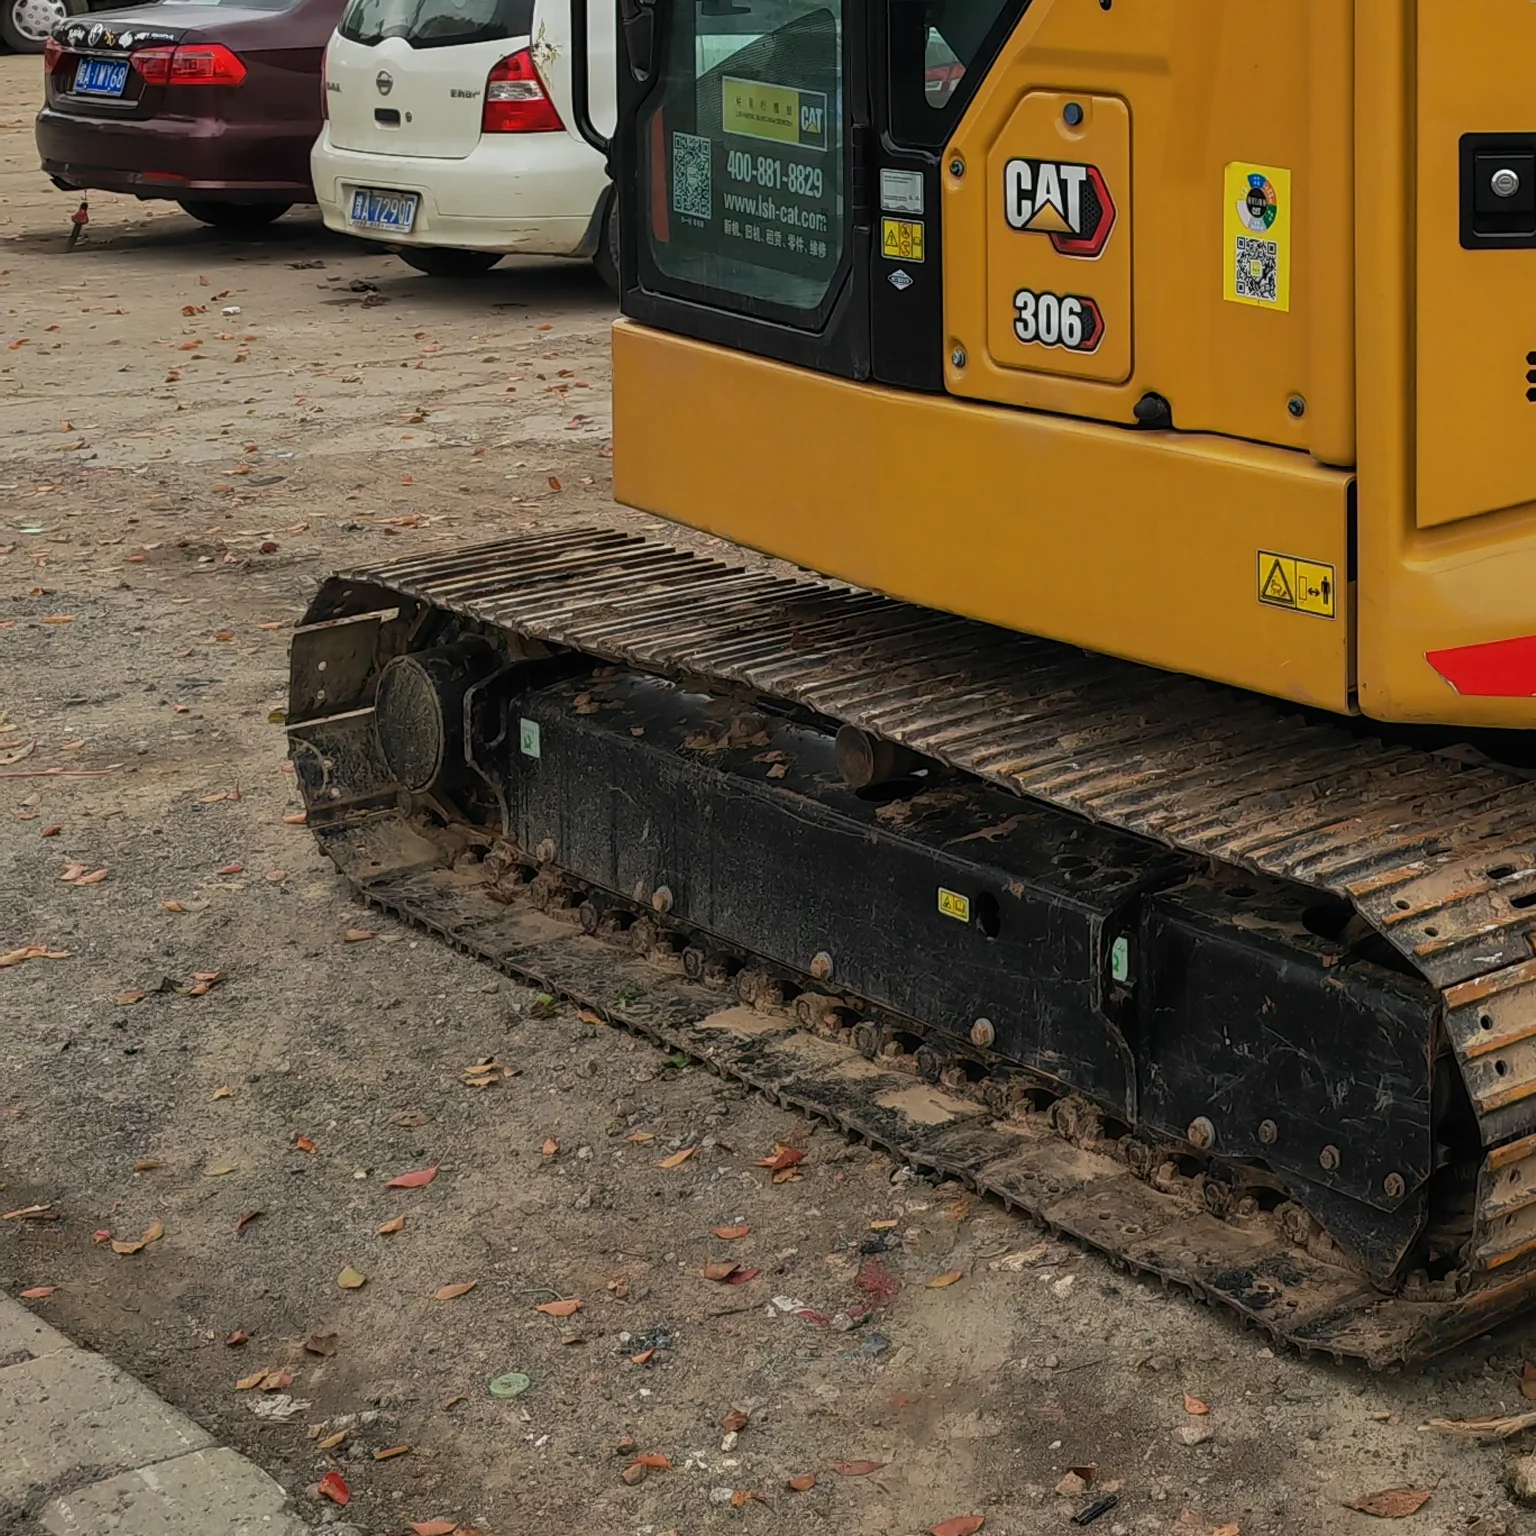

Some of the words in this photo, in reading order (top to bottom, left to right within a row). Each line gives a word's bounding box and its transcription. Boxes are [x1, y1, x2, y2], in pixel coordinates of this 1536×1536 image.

[800, 105, 823, 134] CAT
[726, 150, 823, 199] 400-881-8829
[1006, 160, 1087, 234] CAT
[723, 192, 828, 232] www.lsh-cat.com
[1015, 292, 1082, 347] 306
